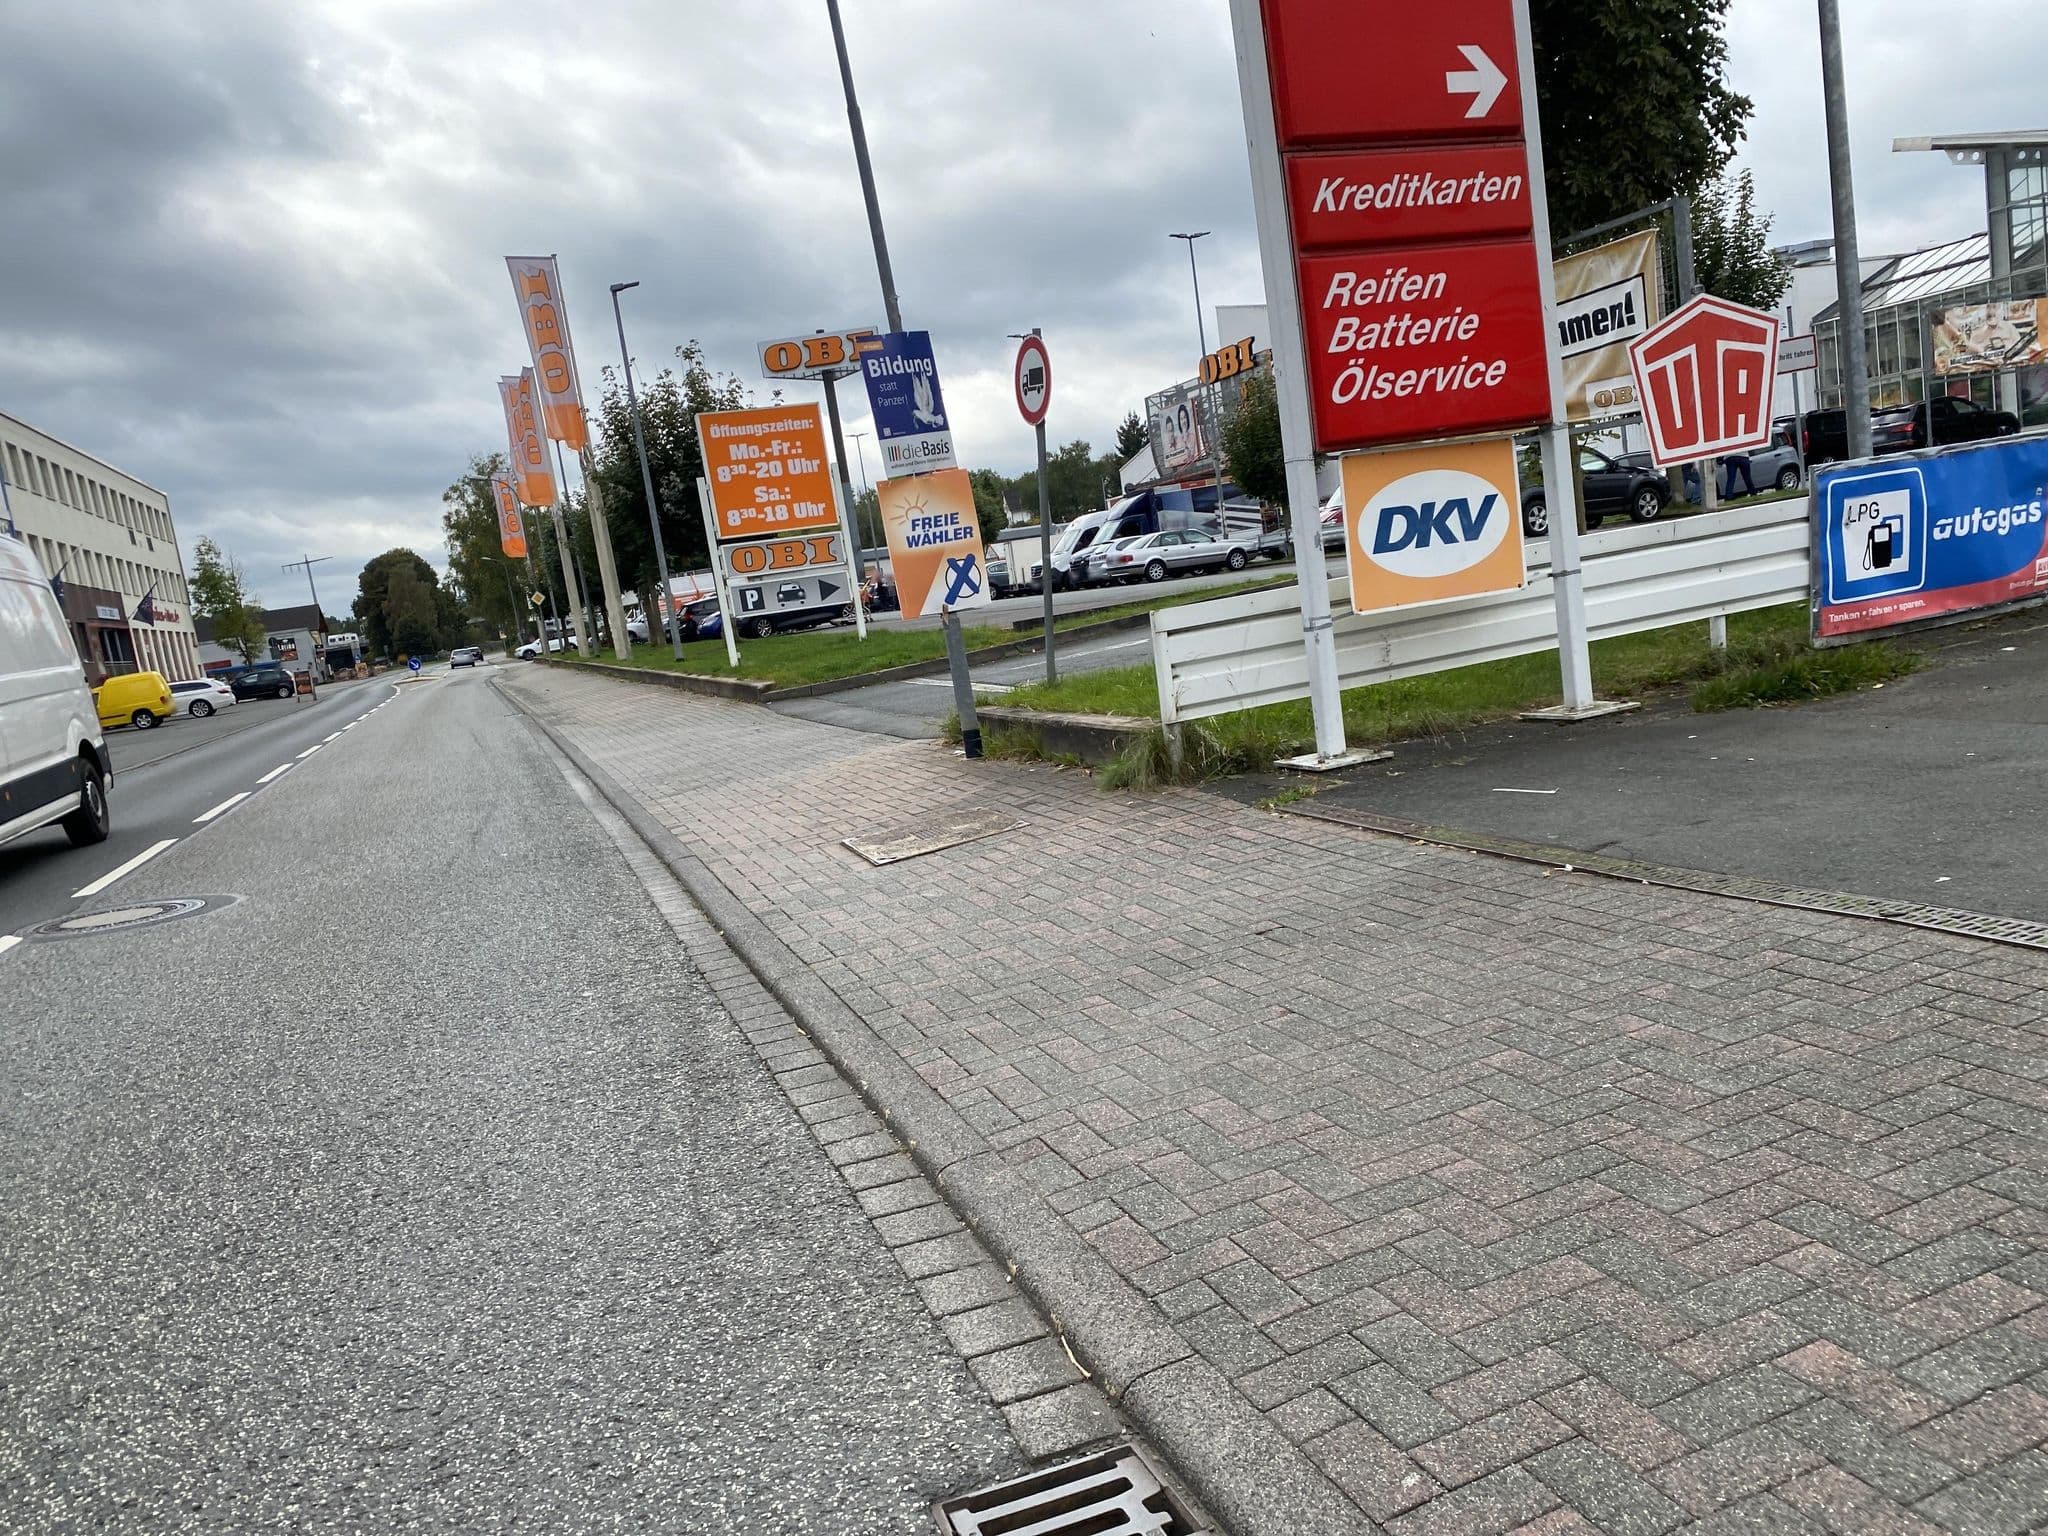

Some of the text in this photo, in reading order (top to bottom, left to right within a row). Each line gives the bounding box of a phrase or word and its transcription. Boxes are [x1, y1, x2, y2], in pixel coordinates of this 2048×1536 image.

[1312, 171, 1522, 213] Kreditkarten
[1322, 266, 1447, 309] Reifen
[517, 268, 570, 394] OBI
[1328, 306, 1480, 354] Batterie
[867, 354, 933, 379] Bildung
[1199, 335, 1255, 385] OBI
[879, 381, 898, 393] statt
[1331, 355, 1507, 405] Ölservice
[1642, 310, 1769, 451] UTA
[877, 393, 908, 408] Panzer!
[710, 418, 814, 438] Öffnungszeiten:
[729, 439, 803, 461] Mo.-Fr.:
[787, 458, 820, 475] Uhr
[754, 485, 791, 503] Sa.:
[793, 501, 826, 519] Uhr
[1847, 501, 1880, 524] LPG
[1932, 501, 2042, 541] autogas
[911, 512, 960, 532] FREIE
[1372, 493, 1499, 555] DKV
[906, 526, 974, 549] WÄHLER
[731, 536, 837, 574] OBI
[746, 589, 760, 610] P
[1829, 611, 1860, 623] Tanken
[1868, 606, 1893, 616] fahren
